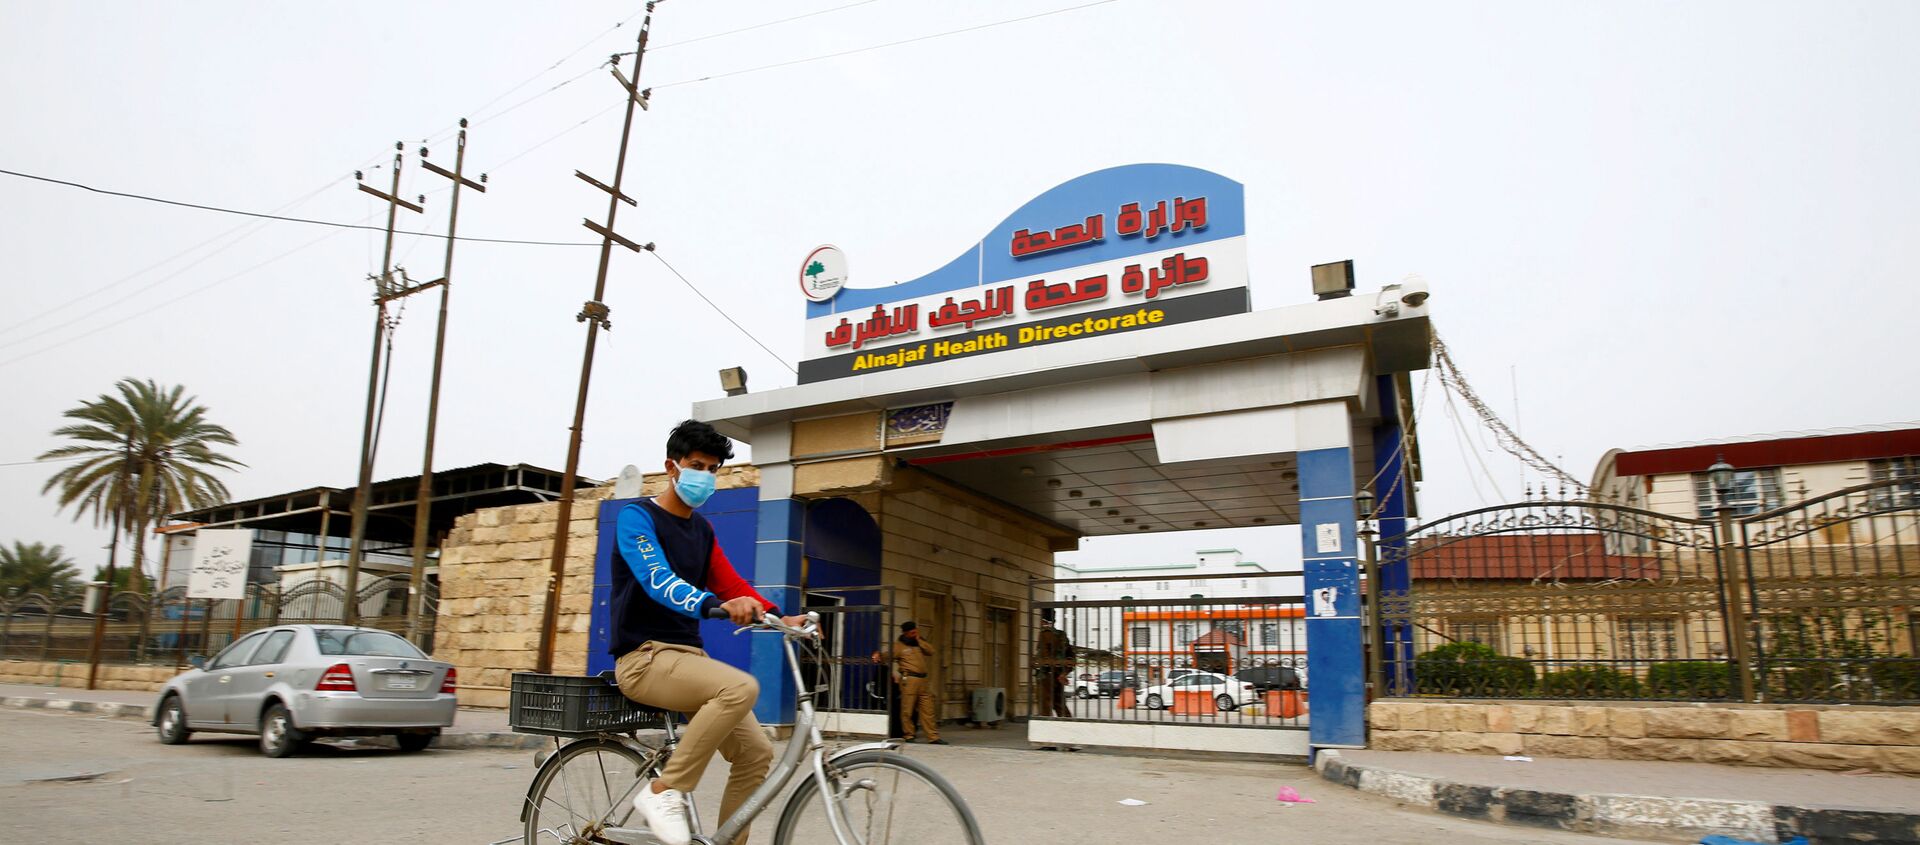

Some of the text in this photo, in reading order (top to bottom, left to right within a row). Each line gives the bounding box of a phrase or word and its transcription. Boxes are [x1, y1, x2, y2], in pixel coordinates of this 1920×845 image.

[1011, 197, 1206, 257] وزارة الصحة
[825, 253, 1209, 350] دائرة صحة النجف الاشرف
[852, 308, 1165, 371] Alnajaf Health Directorate
